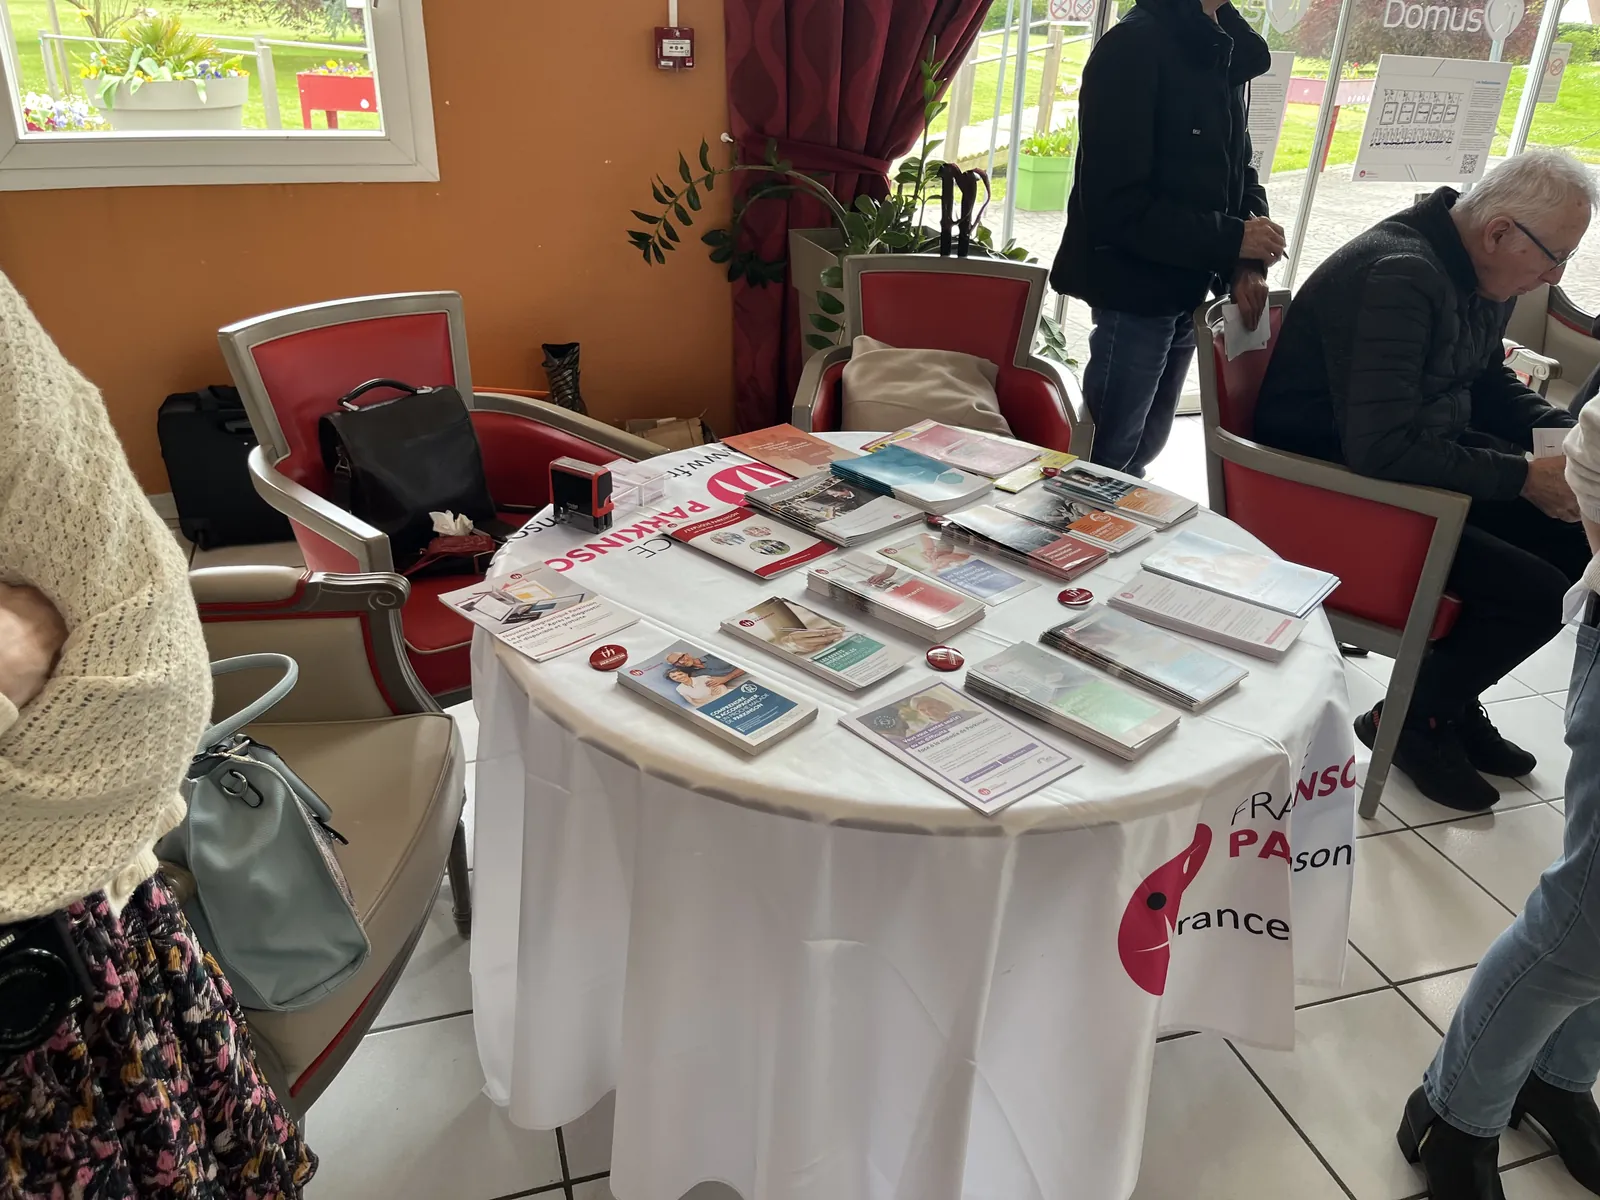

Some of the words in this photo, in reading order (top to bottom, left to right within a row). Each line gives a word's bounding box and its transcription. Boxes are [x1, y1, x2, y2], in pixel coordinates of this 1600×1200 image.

[1384, 0, 1484, 32] Domus
[628, 538, 672, 559] CE
[710, 696, 746, 716] COMPRENDRE
[733, 703, 763, 720] PARKINSON
